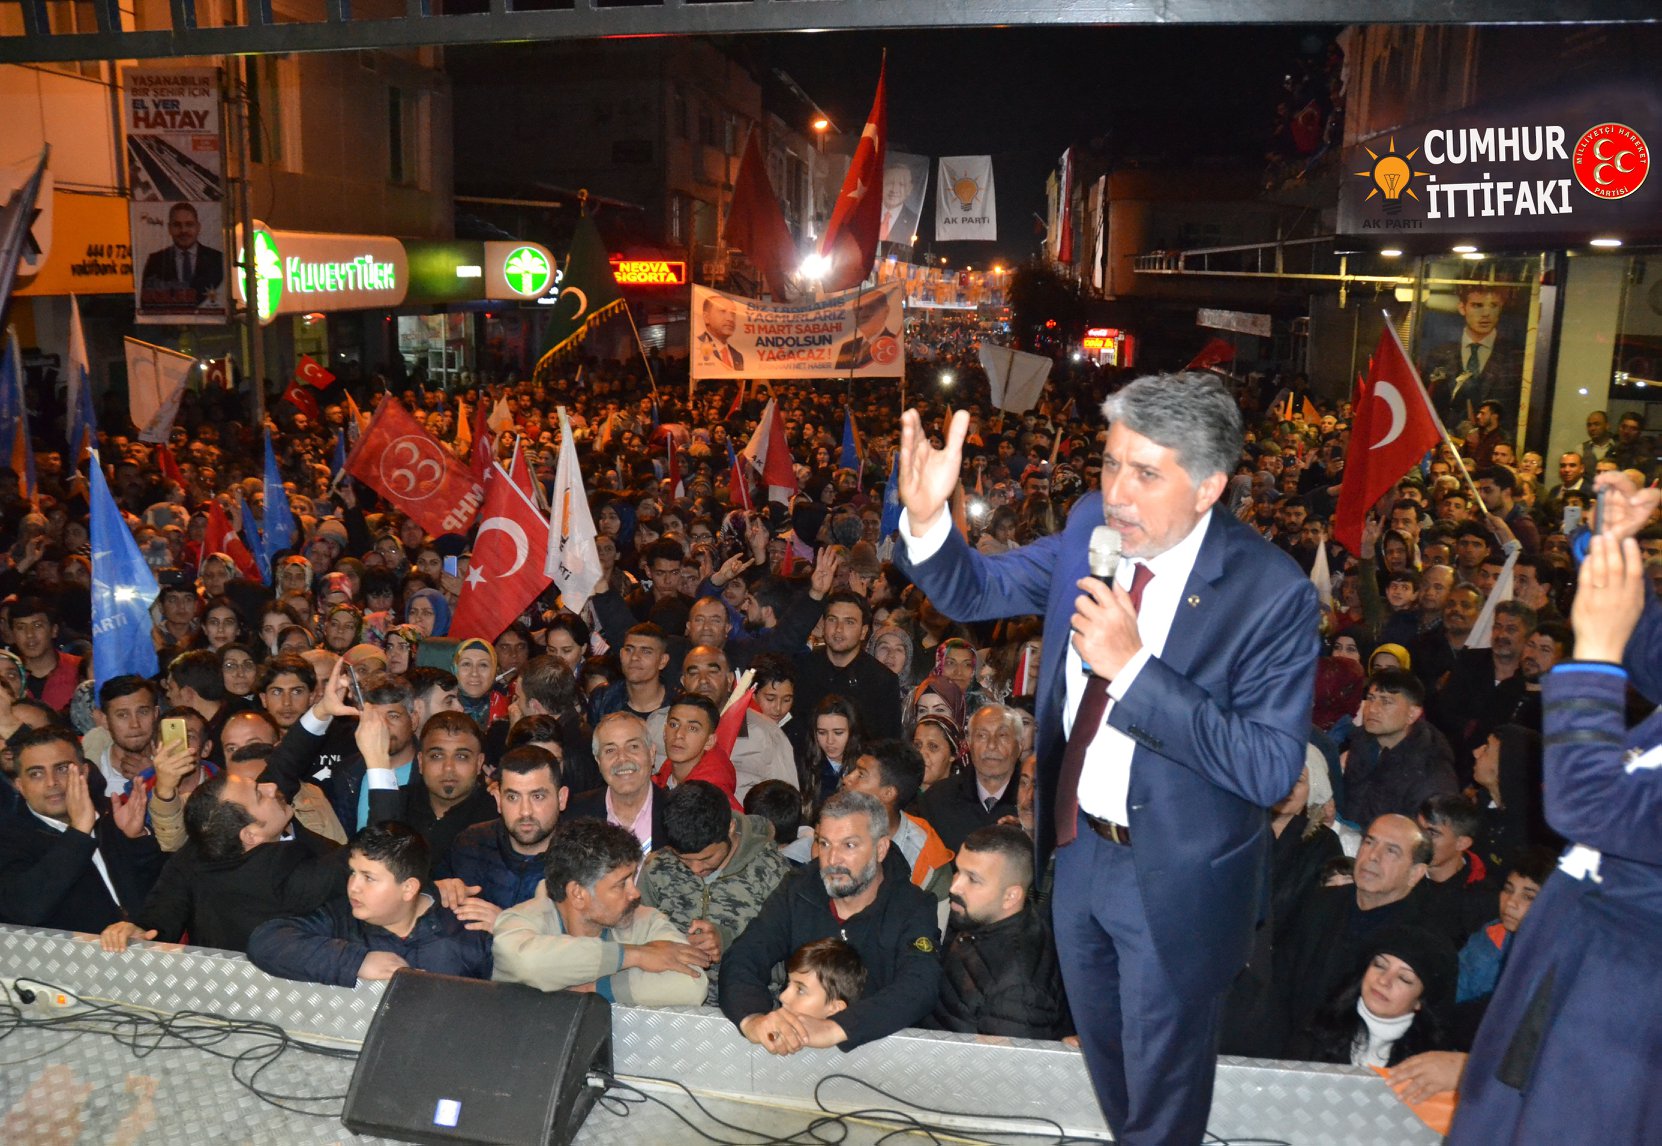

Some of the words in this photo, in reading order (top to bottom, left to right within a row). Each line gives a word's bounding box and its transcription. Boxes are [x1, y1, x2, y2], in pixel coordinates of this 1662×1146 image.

[152, 99, 180, 109] VER
[133, 110, 209, 129] HATAY
[943, 217, 958, 225] AK
[619, 262, 670, 273] NEOVA
[743, 324, 755, 334] 31
[758, 323, 793, 335] MART
[795, 322, 843, 335] SABAHI
[755, 335, 832, 347] ANDOLSUN
